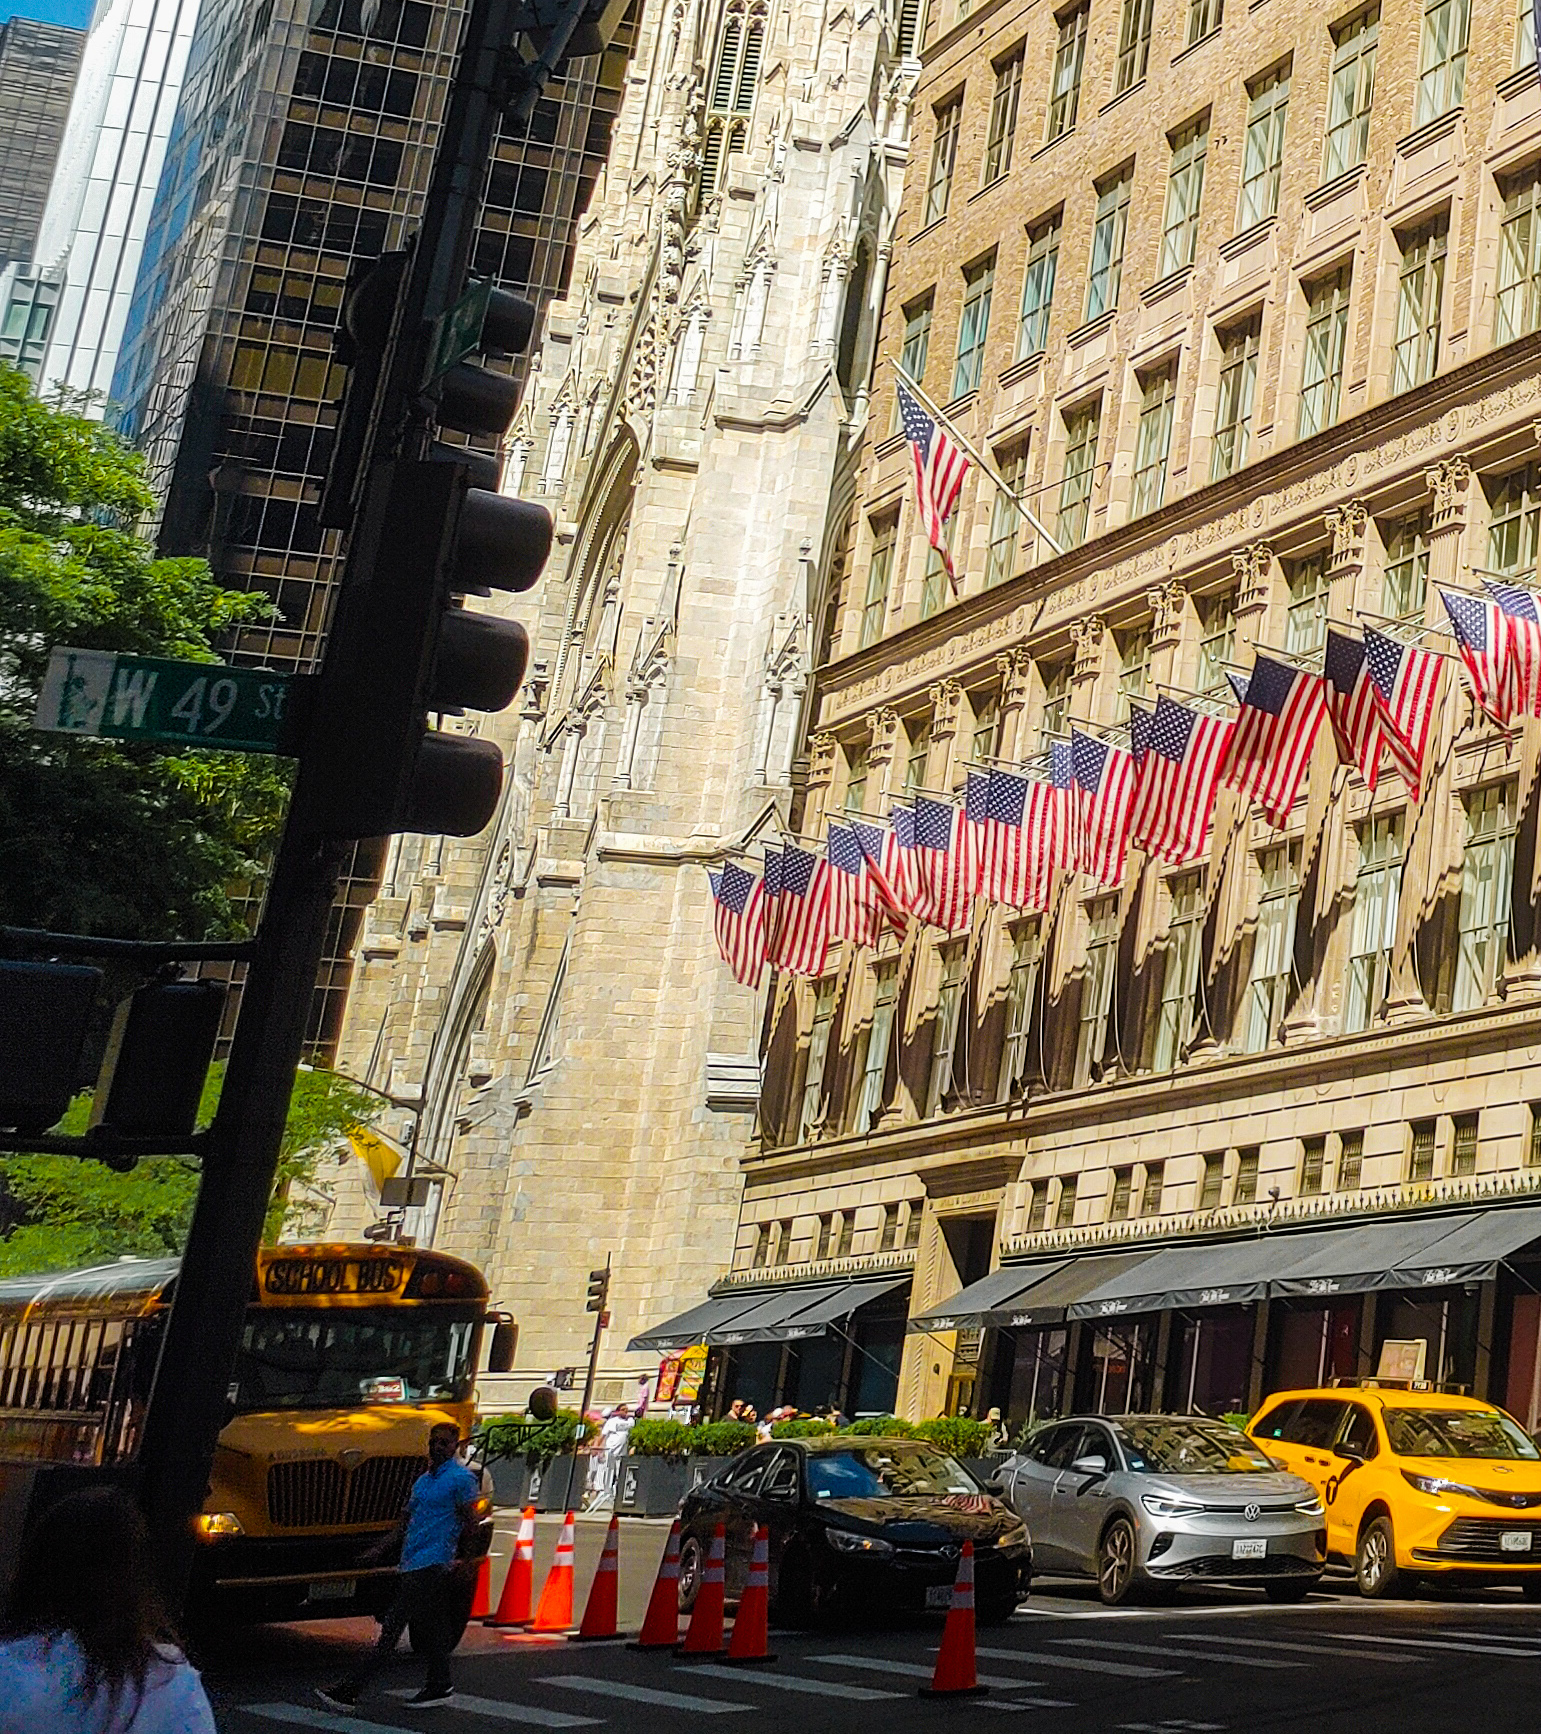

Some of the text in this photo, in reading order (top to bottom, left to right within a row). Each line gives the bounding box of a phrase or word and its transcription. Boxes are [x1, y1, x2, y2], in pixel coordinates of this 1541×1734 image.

[113, 668, 288, 736] W 49 St
[271, 1259, 400, 1293] SCHOOL BUS
